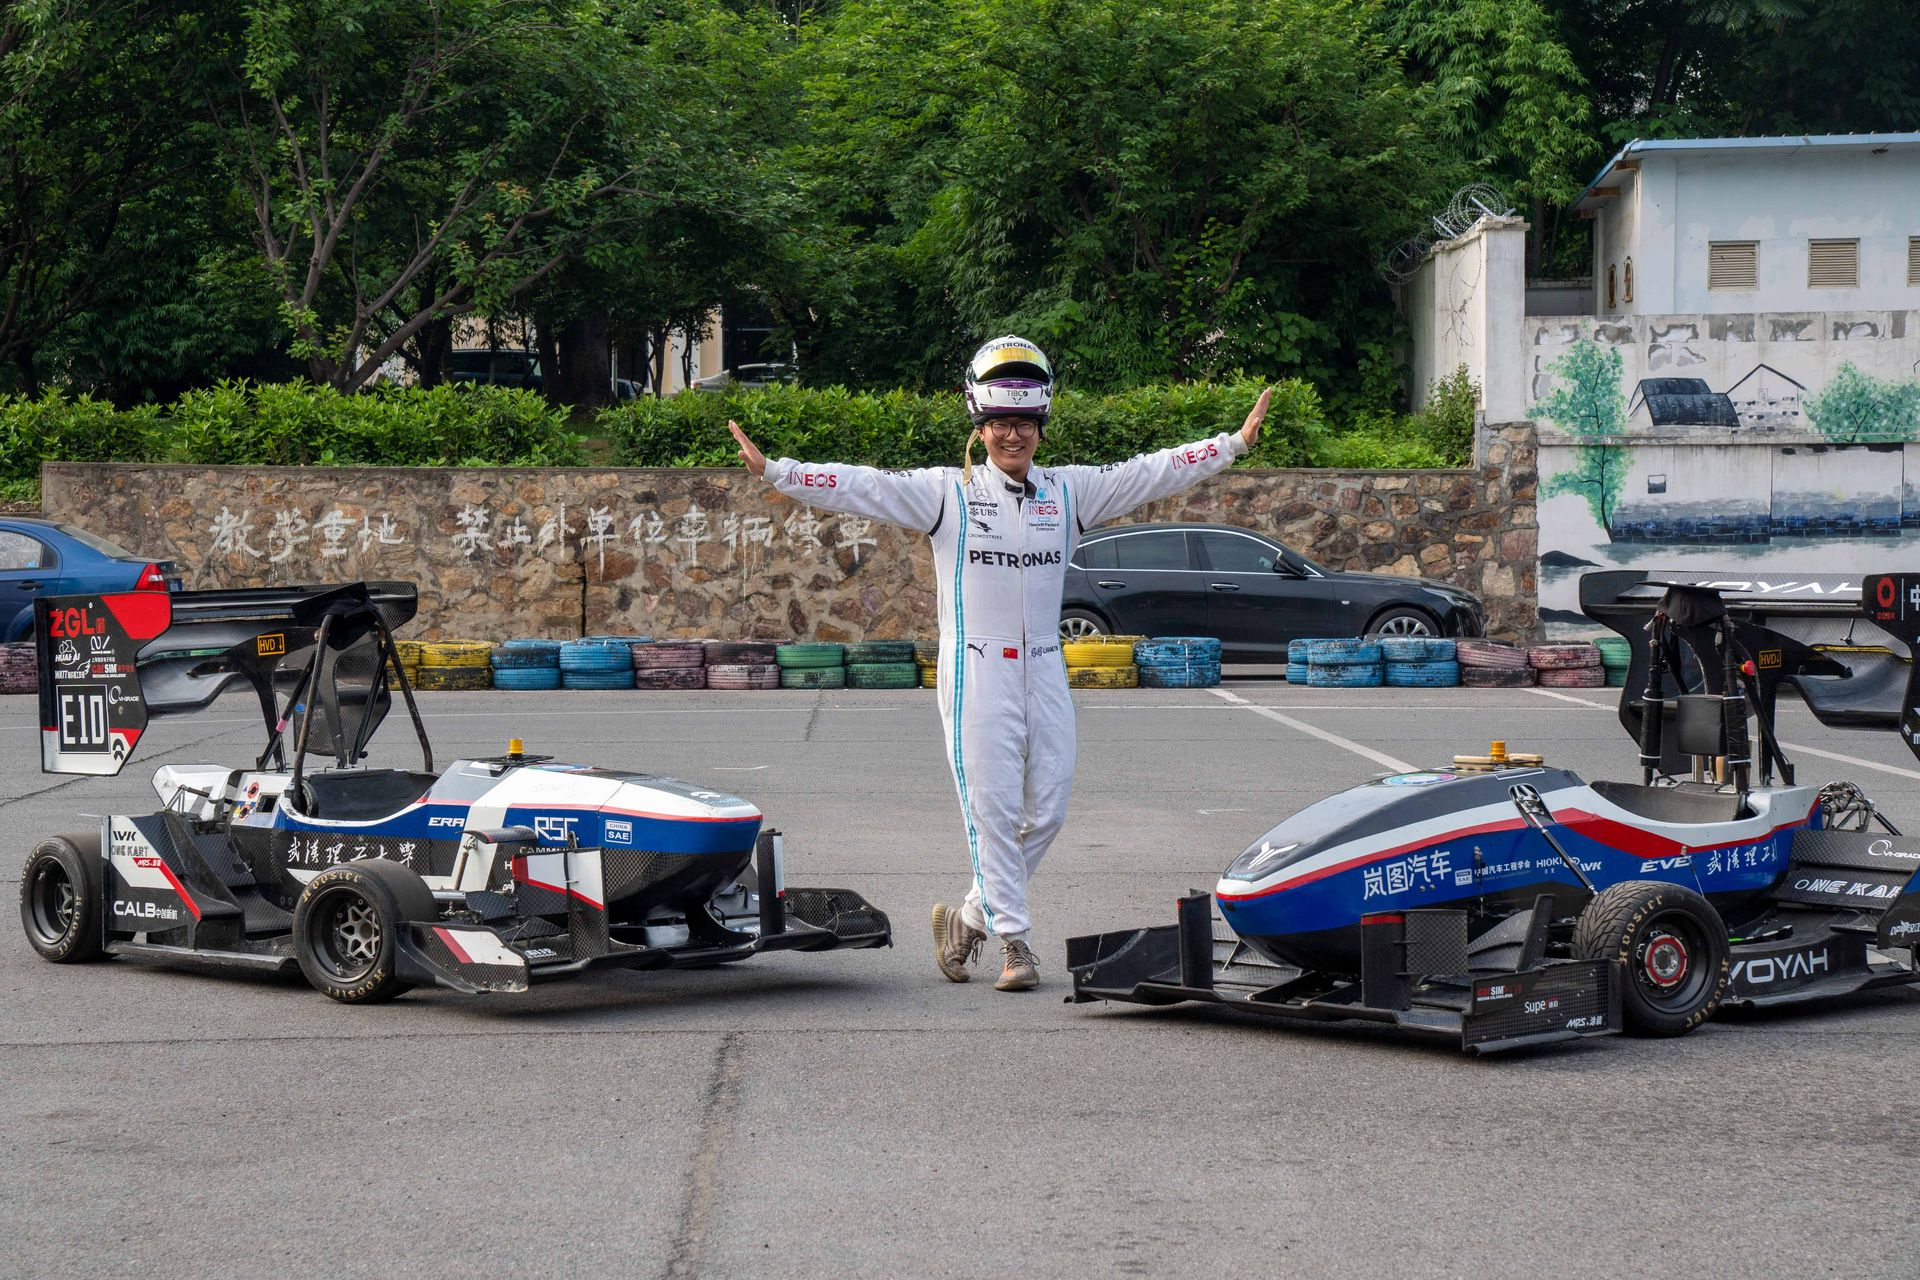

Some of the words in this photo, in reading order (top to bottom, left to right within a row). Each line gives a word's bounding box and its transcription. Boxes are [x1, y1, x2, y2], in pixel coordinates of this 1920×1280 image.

[991, 342, 1038, 352] PETRONAS
[1171, 443, 1218, 470] INEOS
[789, 471, 837, 488] INEOS
[1029, 506, 1058, 515] INEOS
[969, 550, 1061, 569] PETRONAS
[259, 638, 276, 652] HVD
[608, 831, 629, 840] SAE
[127, 846, 149, 857] KART
[1537, 857, 1563, 868] HIOKI
[1640, 855, 1691, 873] EVE
[1363, 850, 1452, 900] 岚图汽车
[113, 900, 156, 918] CALB
